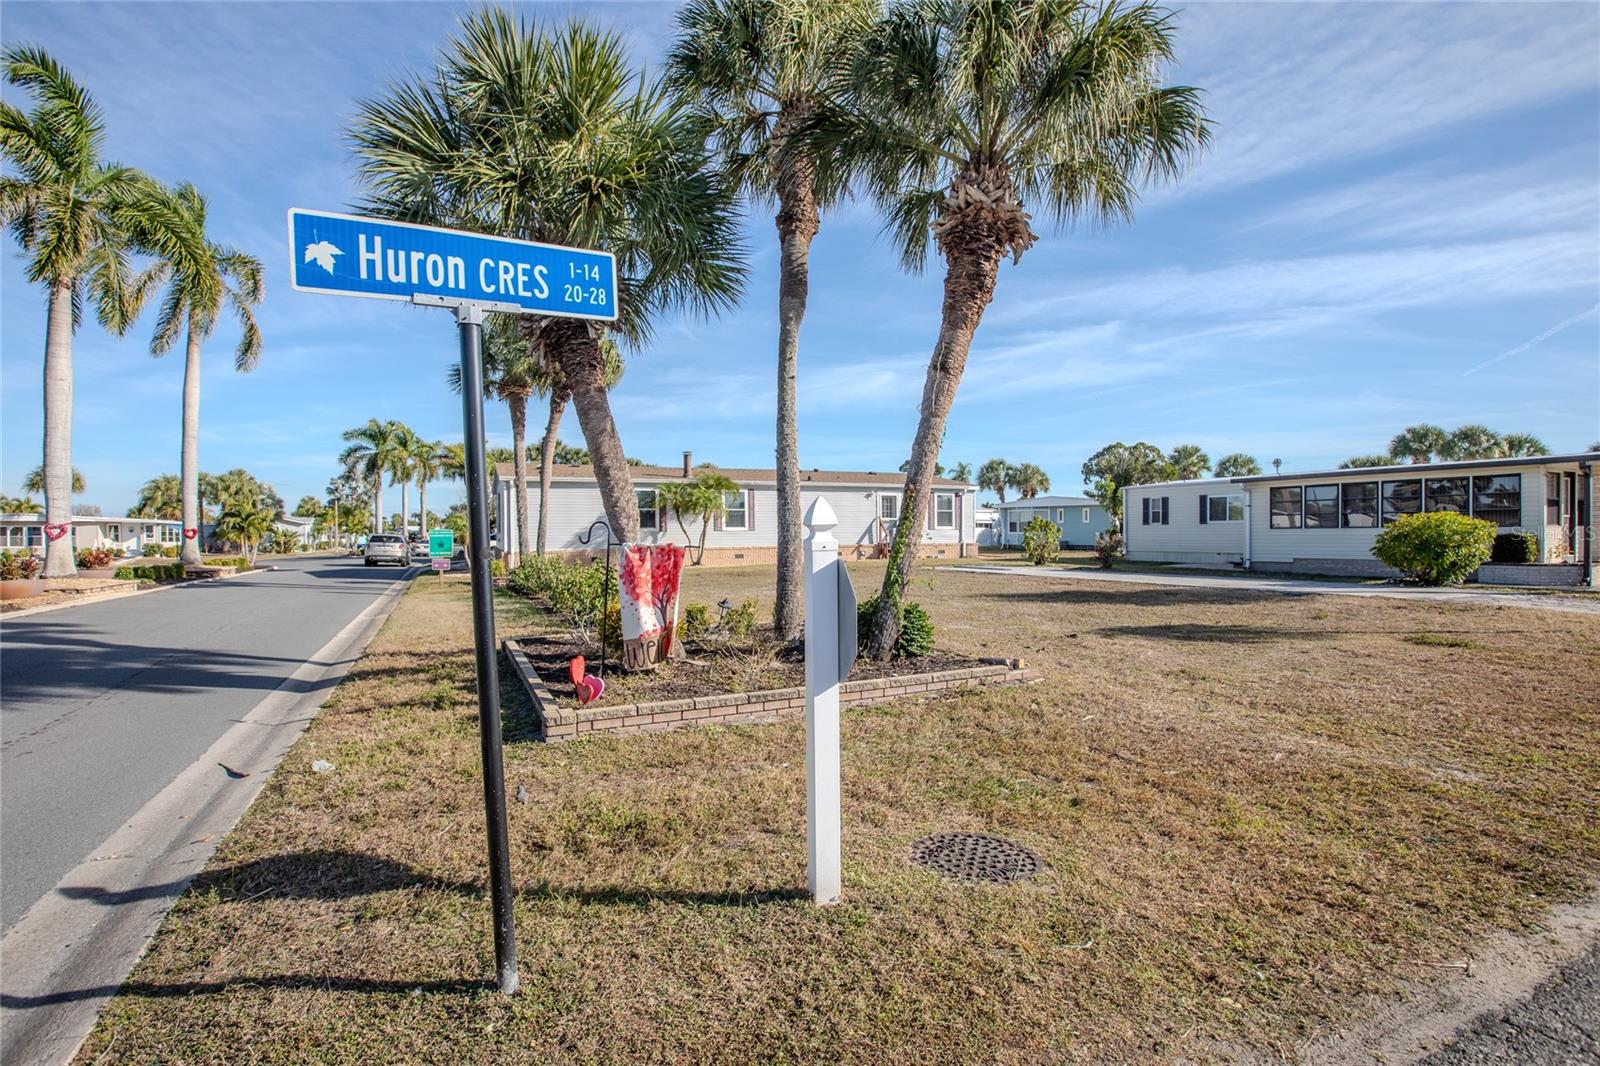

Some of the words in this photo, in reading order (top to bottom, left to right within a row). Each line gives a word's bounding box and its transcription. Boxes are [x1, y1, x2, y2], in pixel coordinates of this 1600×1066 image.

[358, 234, 465, 290] Huron
[479, 258, 549, 299] CRES
[569, 262, 600, 281] 1-14
[564, 284, 606, 305] 20-28
